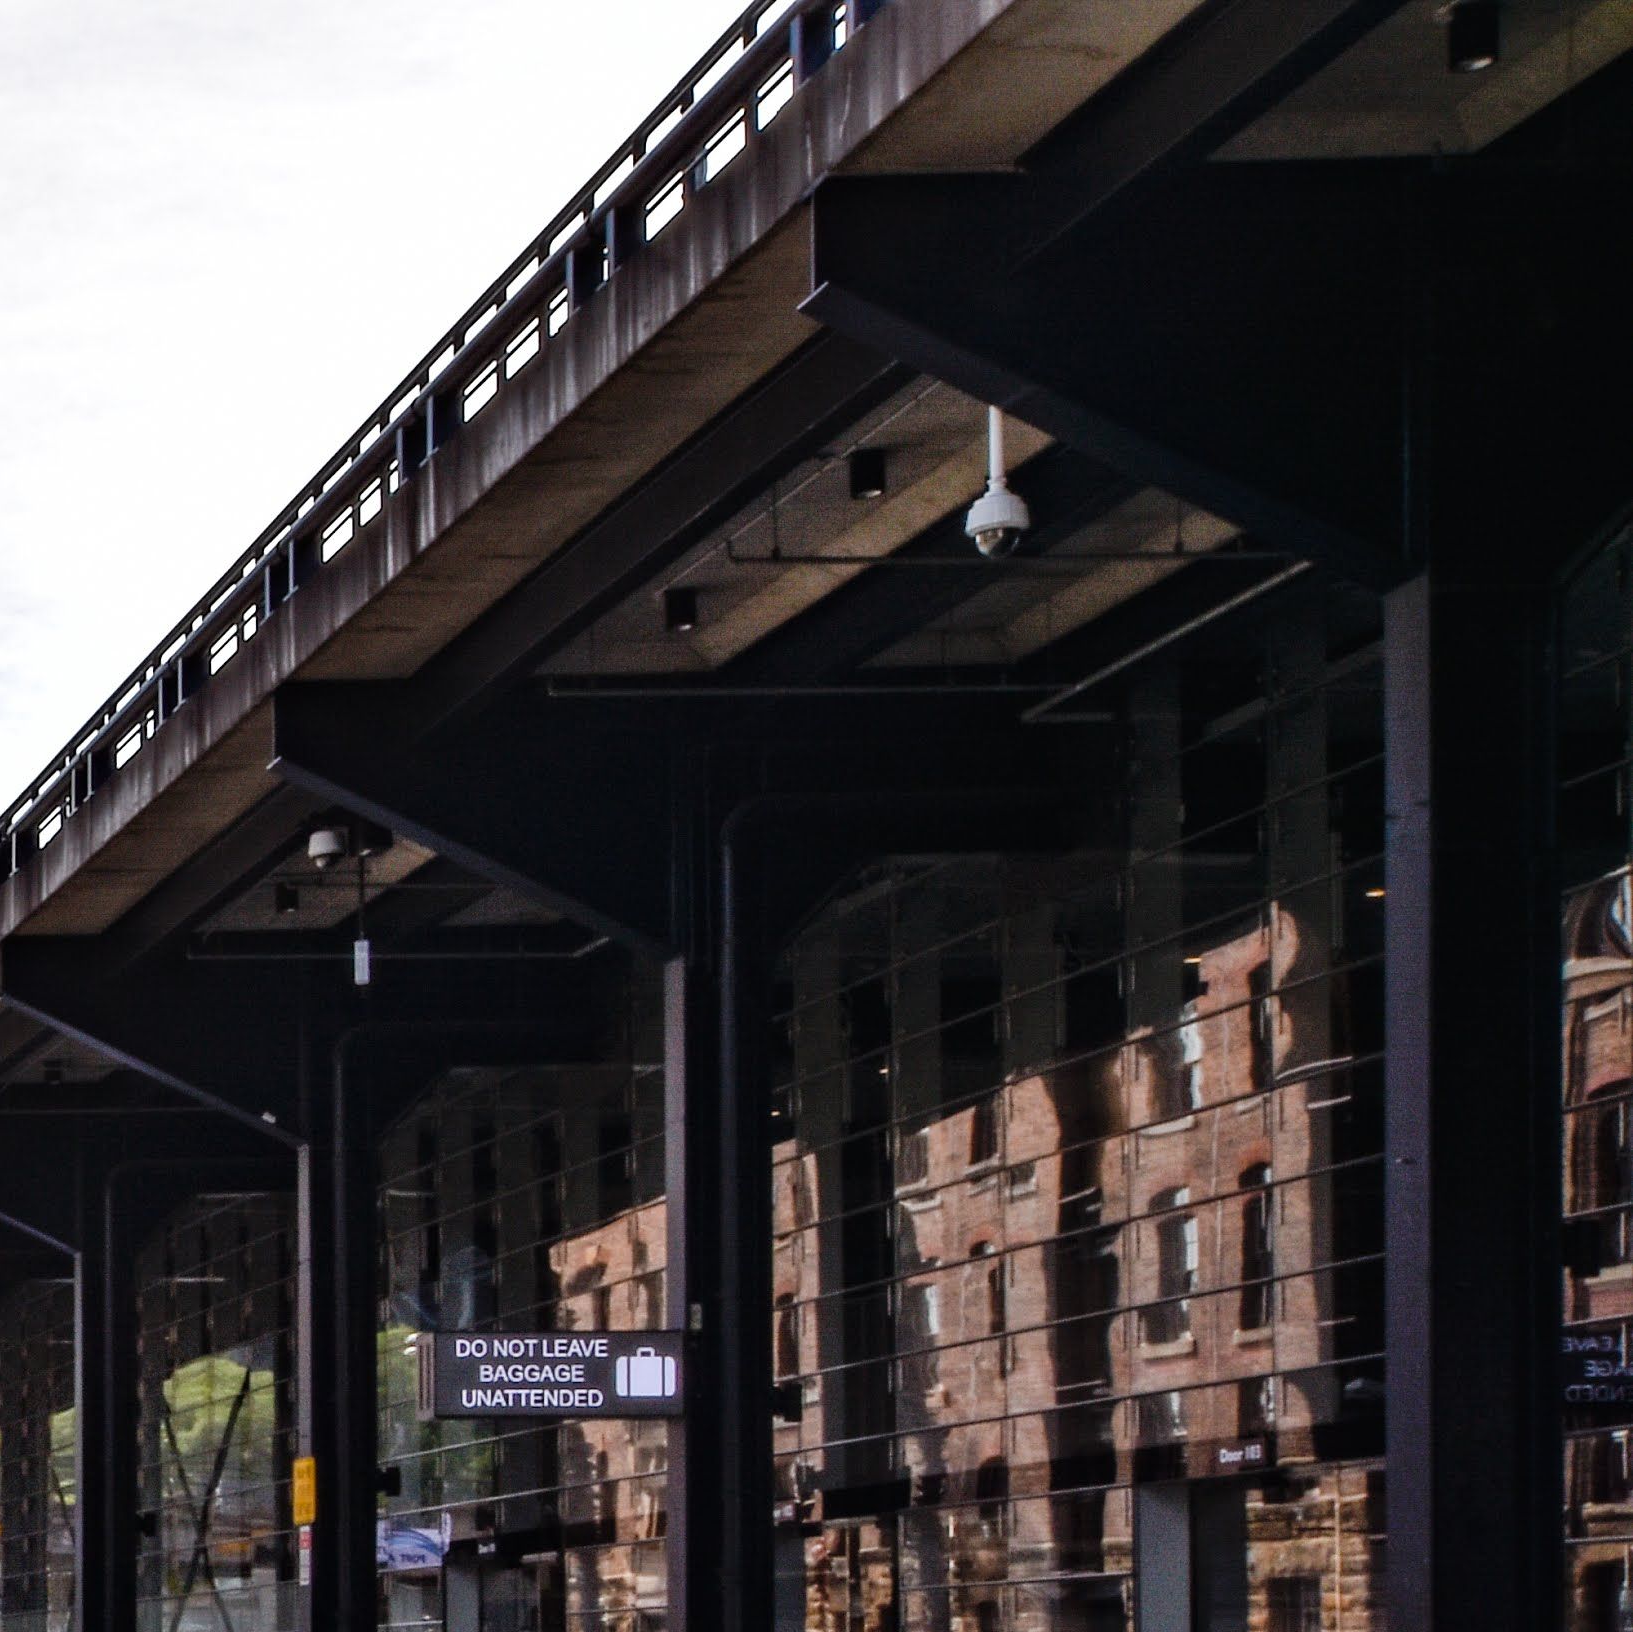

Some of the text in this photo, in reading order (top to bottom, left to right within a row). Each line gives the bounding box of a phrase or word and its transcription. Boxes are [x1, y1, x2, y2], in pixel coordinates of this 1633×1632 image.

[455, 1339, 608, 1358] DO NOT LEAVE
[479, 1365, 584, 1383] BAGGAGE
[462, 1389, 603, 1408] UNATTENDED
